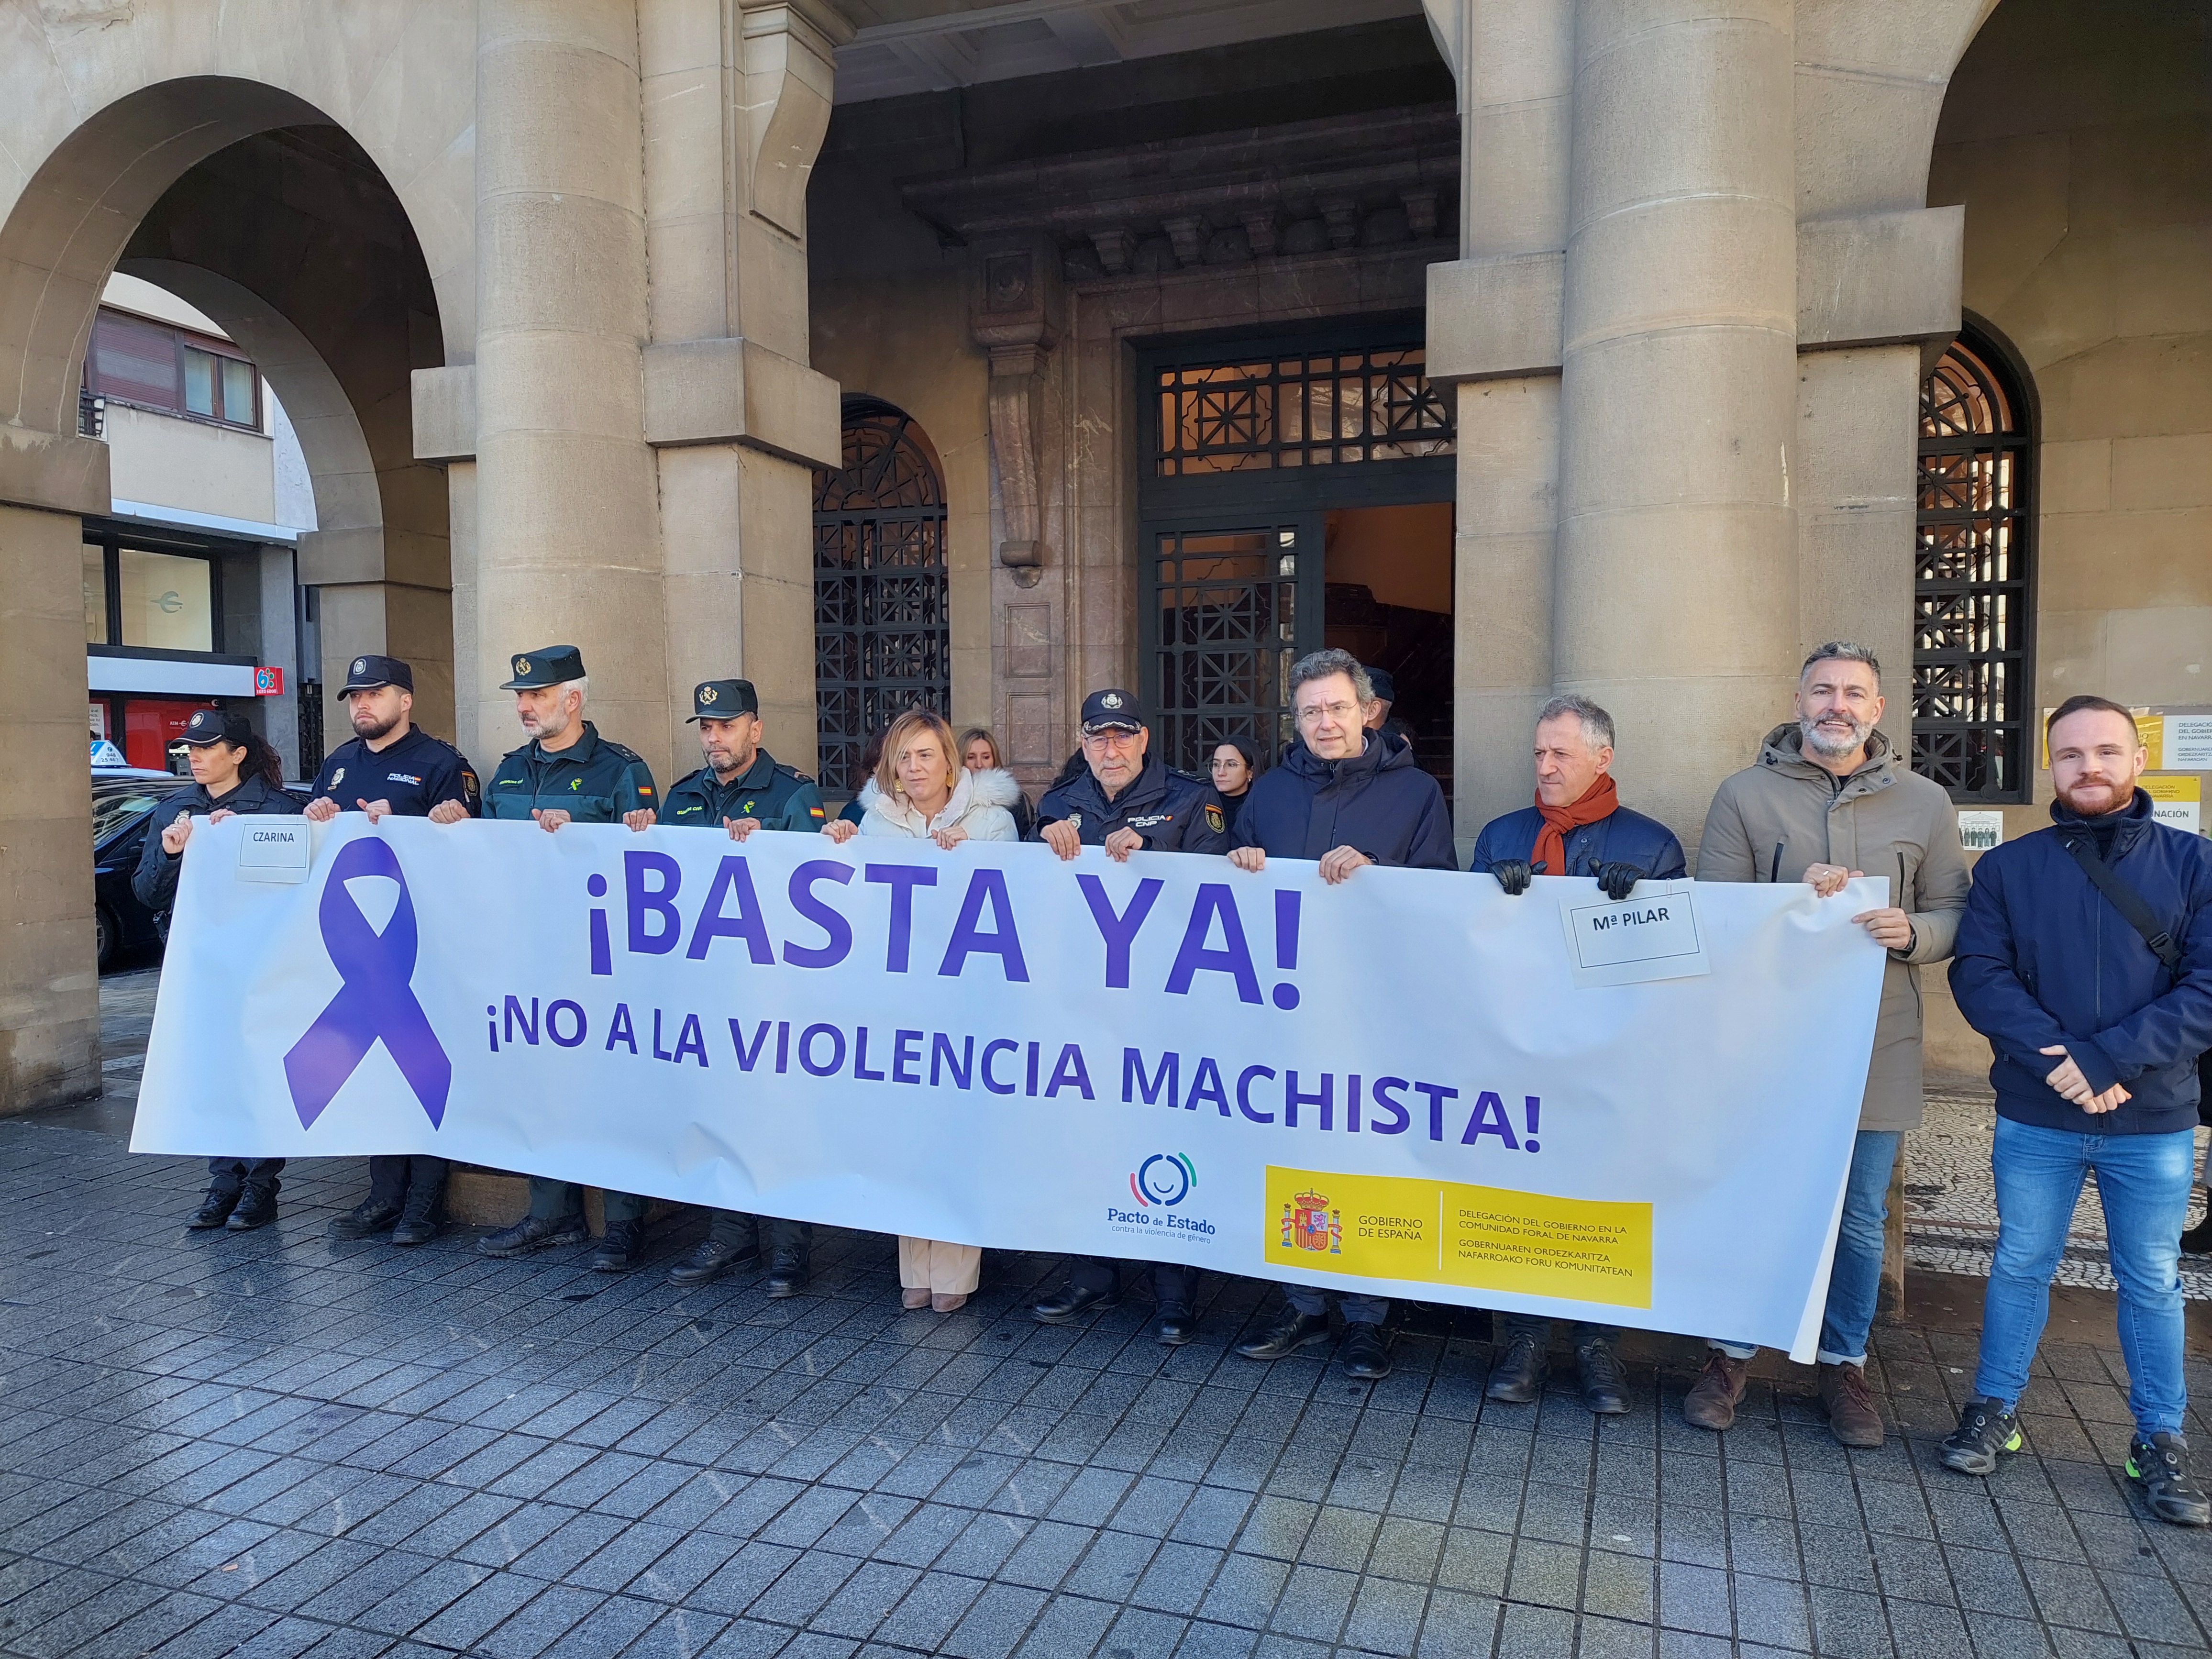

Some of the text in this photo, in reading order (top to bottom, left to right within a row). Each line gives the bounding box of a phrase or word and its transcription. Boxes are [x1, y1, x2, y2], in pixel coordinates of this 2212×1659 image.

[387, 776, 420, 785] NACIONAL
[1128, 815, 1166, 823] POLICIA
[2151, 808, 2189, 818] NACIÓN
[253, 832, 295, 842] CZARINA
[587, 851, 1301, 1010] ¡BASTA YA!
[1593, 907, 1670, 931] Mª PILAR
[487, 995, 1539, 1152] ¡NO A LA VIOLENCIA MACHISTA!
[1107, 1208, 1216, 1235] Pacto de Estado
[1359, 1215, 1423, 1228] GOBIERNO
[1459, 1220, 1520, 1235] COMUNIDAD
[1523, 1228, 1555, 1239] FORAL
[1572, 1234, 1619, 1244] NAVARRA
[1460, 1209, 1520, 1224] DELEGACIÓN
[1523, 1217, 1541, 1227] DEL
[1543, 1221, 1596, 1232] GOBIERNO
[1615, 1226, 1627, 1234] LA
[1137, 1226, 1143, 1234] la
[1144, 1228, 1175, 1238] violencia
[1177, 1231, 1186, 1239] de
[1187, 1233, 1211, 1244] género
[1359, 1227, 1422, 1241] DE ESPAÑA
[1459, 1239, 1611, 1262] GOBERNUAREN ORDEZKARITZA
[1459, 1250, 1632, 1277] NAFARROAKO FORU KOMUNITATEAN
